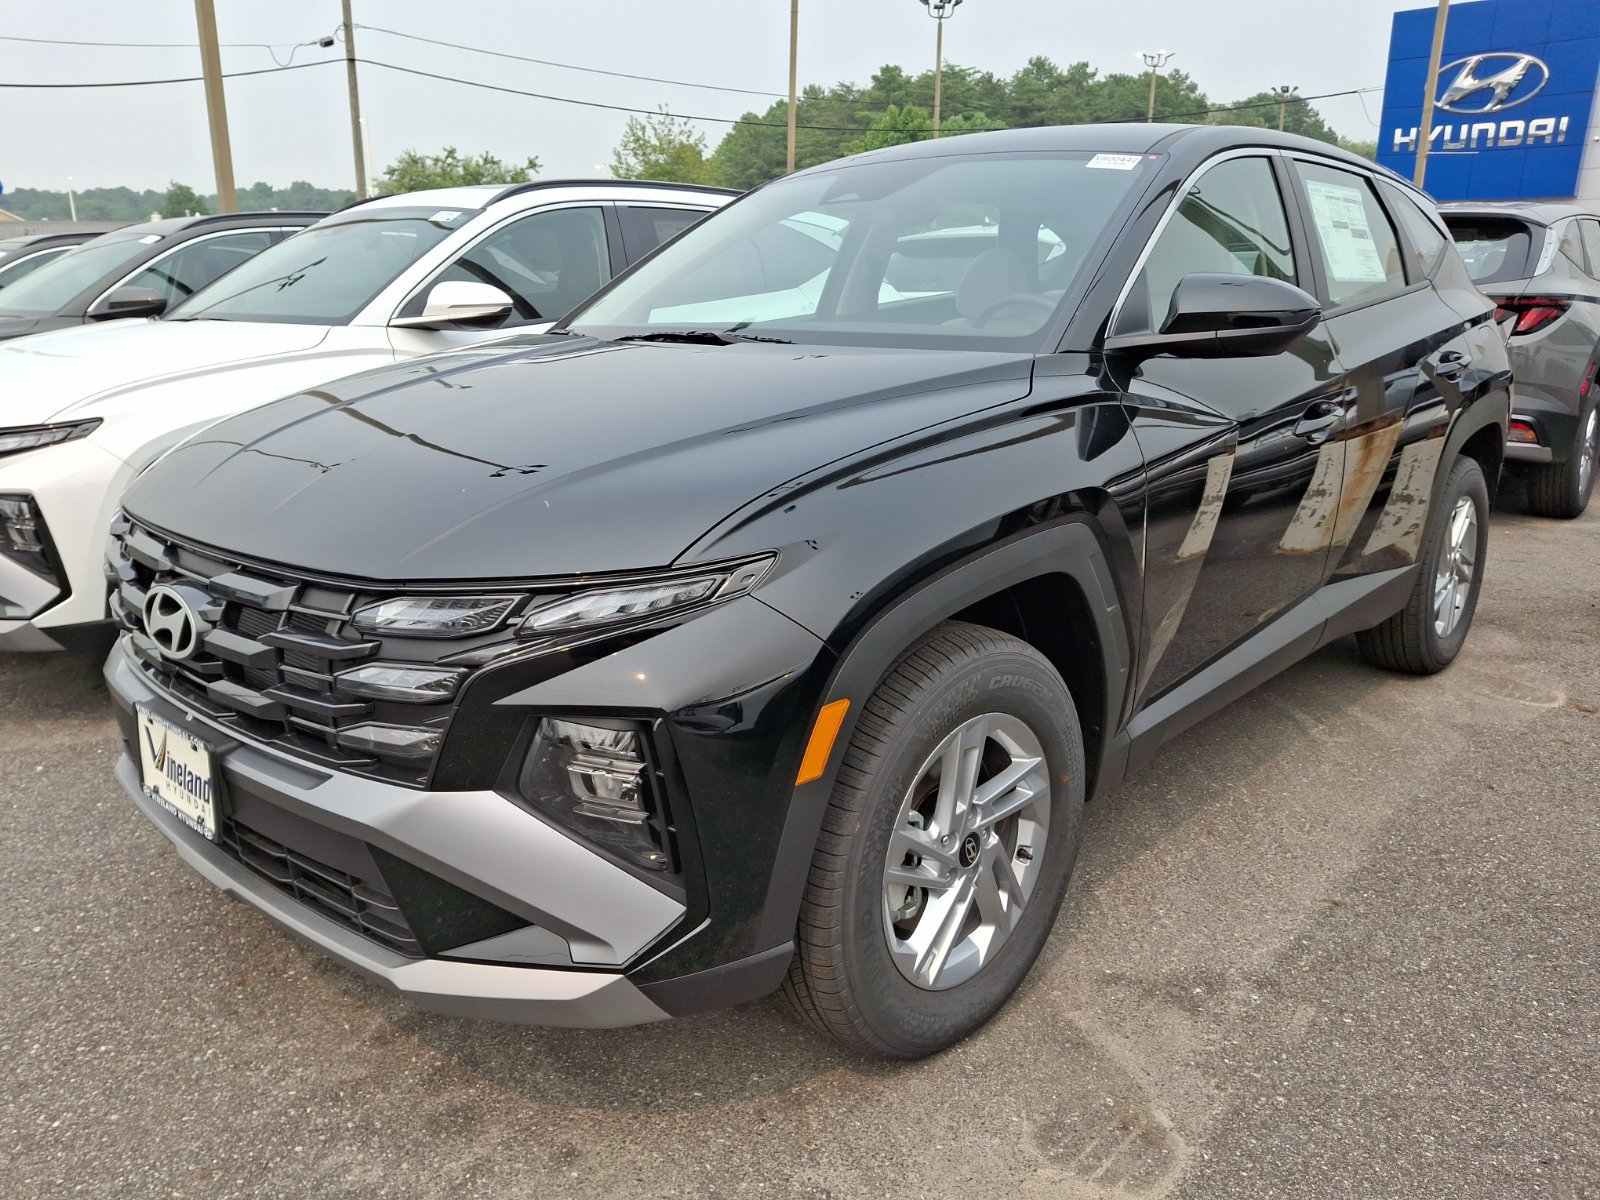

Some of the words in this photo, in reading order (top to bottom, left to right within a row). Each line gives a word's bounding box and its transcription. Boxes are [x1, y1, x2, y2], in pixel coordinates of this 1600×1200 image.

[1393, 116, 1569, 152] HYUNDAI
[151, 792, 178, 816] VINELAND
[177, 809, 205, 835] HYUNDAI
[165, 780, 211, 818] HYUNDAI
